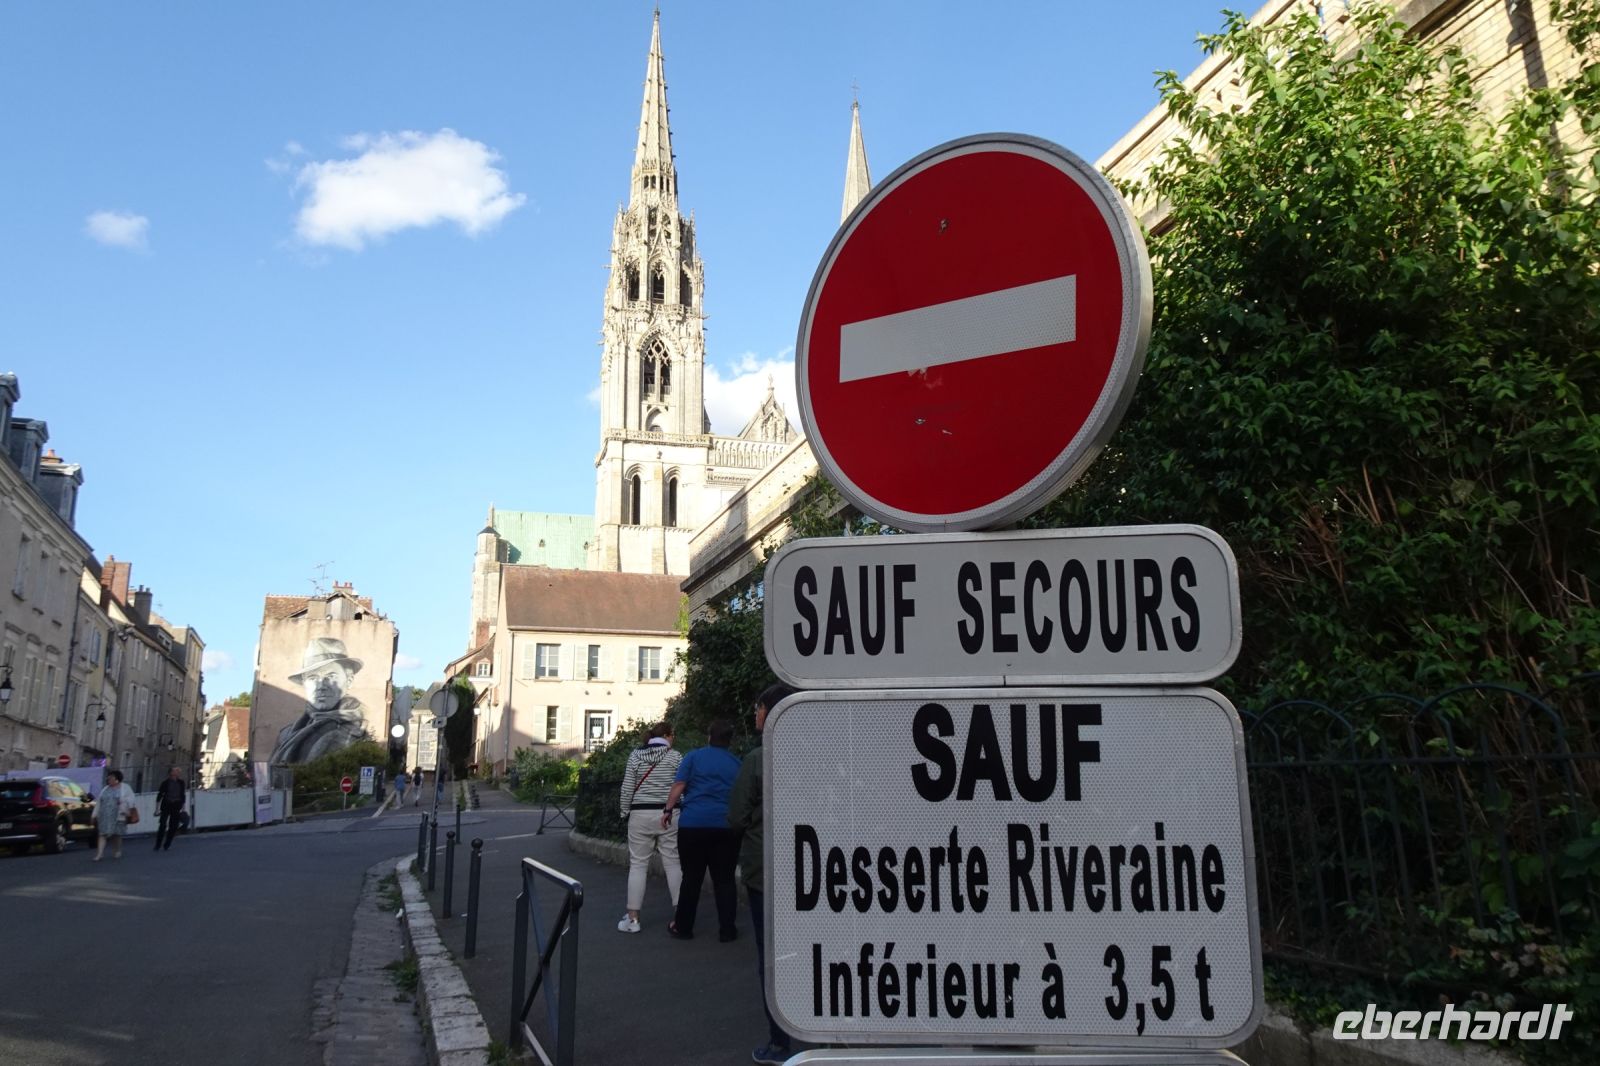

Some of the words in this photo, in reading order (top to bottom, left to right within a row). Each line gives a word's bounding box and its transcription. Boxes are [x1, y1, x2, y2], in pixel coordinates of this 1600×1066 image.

[792, 564, 917, 657] SAUF
[957, 556, 1201, 655] SECOURS
[910, 702, 1103, 803] SAUF
[794, 824, 989, 914] Desserte
[1006, 821, 1226, 914] Riveraine
[812, 941, 1021, 1020] Inférieur
[1041, 942, 1067, 1020] à
[1103, 944, 1176, 1037] 3,5
[1194, 946, 1215, 1022] t
